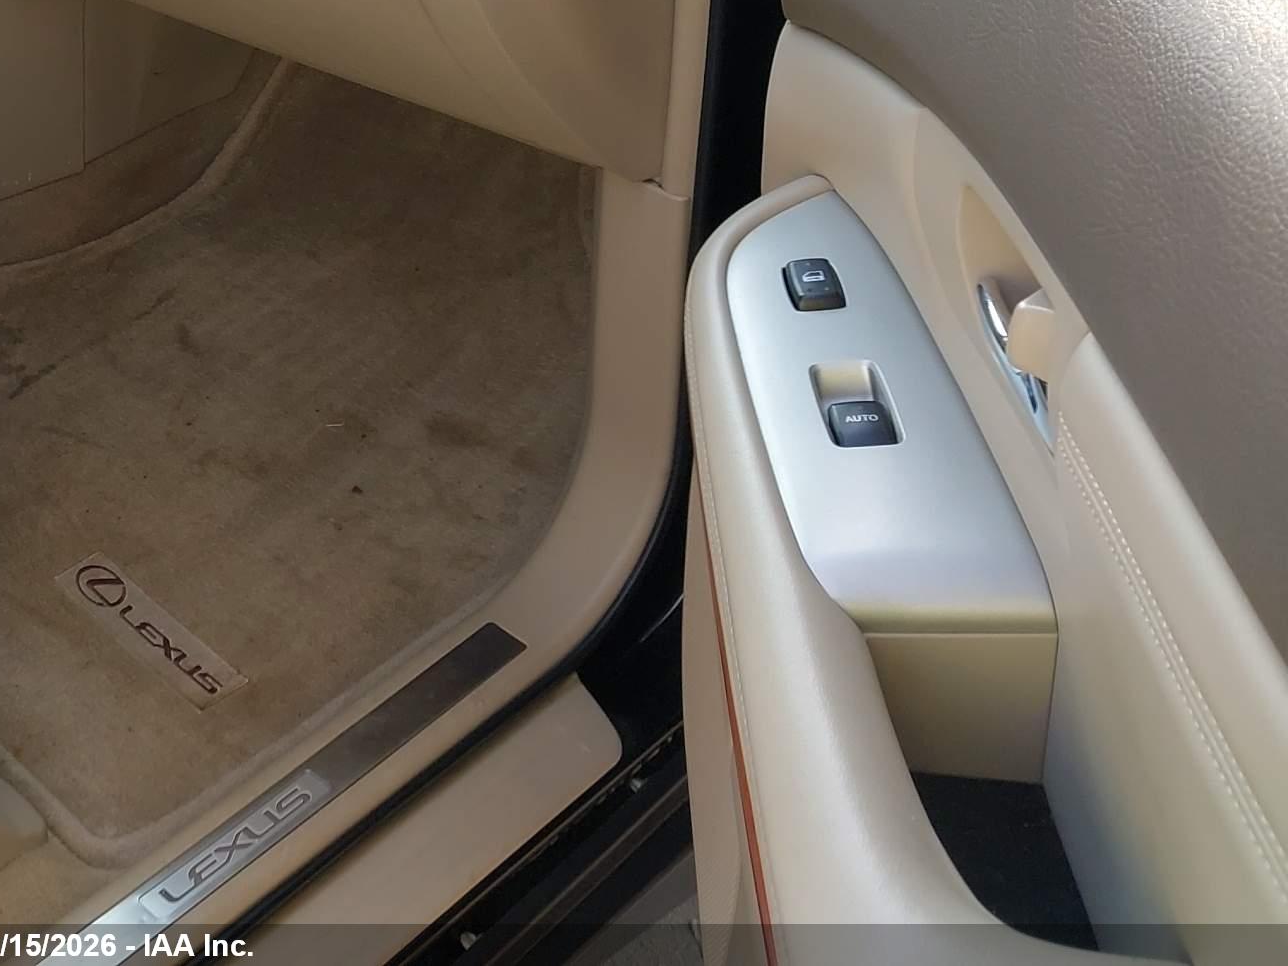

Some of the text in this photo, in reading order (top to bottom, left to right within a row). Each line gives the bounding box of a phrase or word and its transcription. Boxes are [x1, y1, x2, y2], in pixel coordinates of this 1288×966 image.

[845, 413, 880, 424] AUTO
[119, 605, 224, 695] LEXUS
[159, 786, 312, 903] LEXUS
